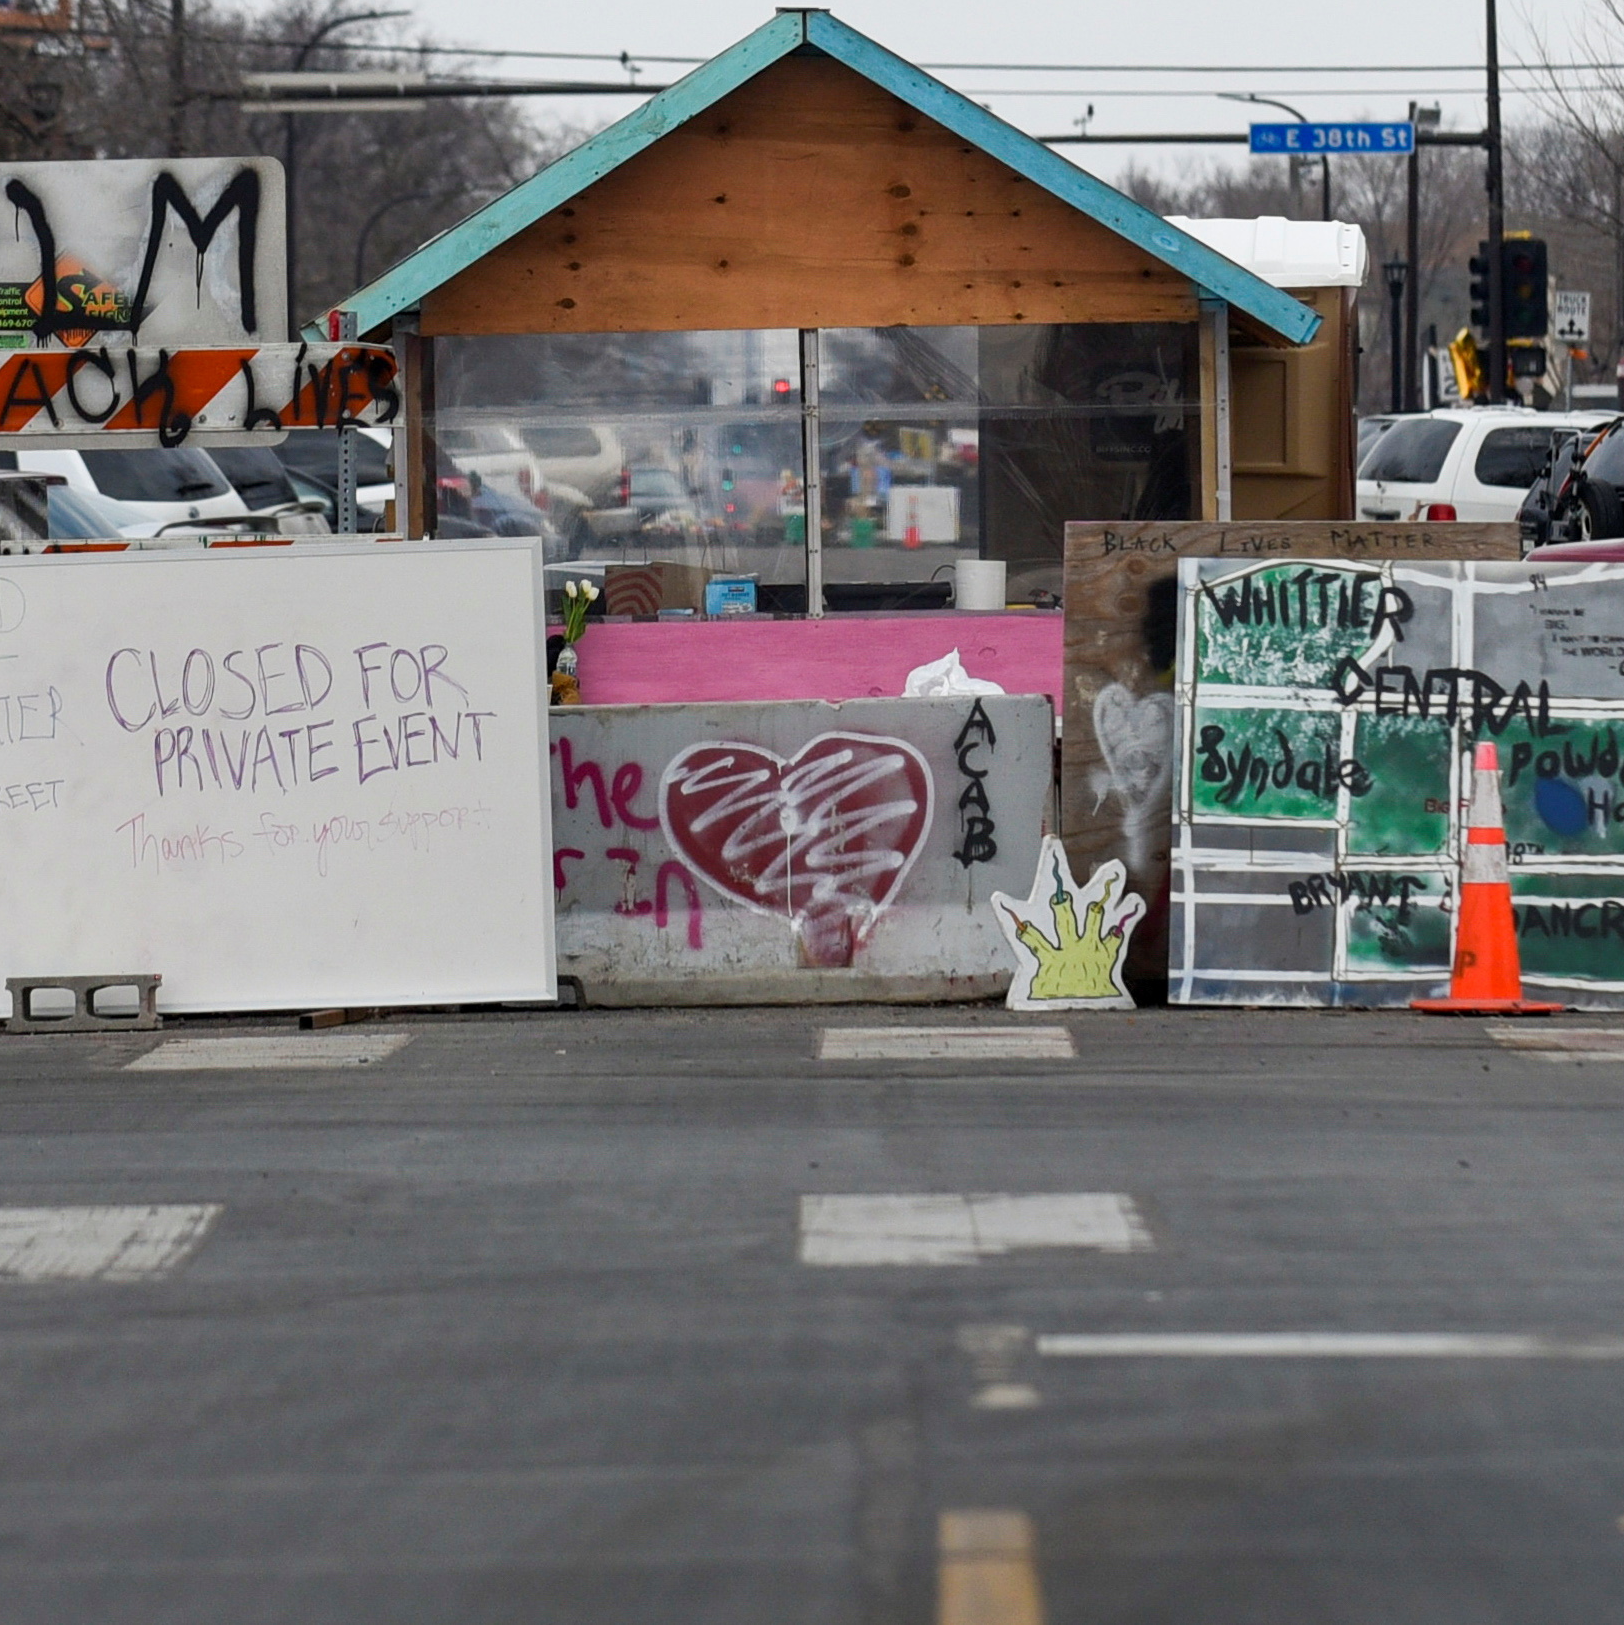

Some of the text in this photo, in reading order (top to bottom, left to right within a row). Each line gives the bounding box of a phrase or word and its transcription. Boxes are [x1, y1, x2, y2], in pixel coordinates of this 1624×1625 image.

[1286, 126, 1408, 148] E 38th St
[1557, 305, 1587, 315] ROUTE
[1558, 293, 1587, 305] TRUCK
[1103, 530, 1175, 556] BLACK
[1330, 529, 1435, 549] MATTER
[1200, 569, 1414, 643] WHITTIER
[1529, 573, 1549, 592] 94
[105, 641, 470, 733] CLOSED FOR
[1331, 655, 1576, 739] CENTRAL
[154, 711, 497, 797] PRIVATE EVENT
[549, 735, 660, 830] he
[116, 799, 492, 877] Thanks for your support
[1287, 871, 1427, 926] BRYANT
